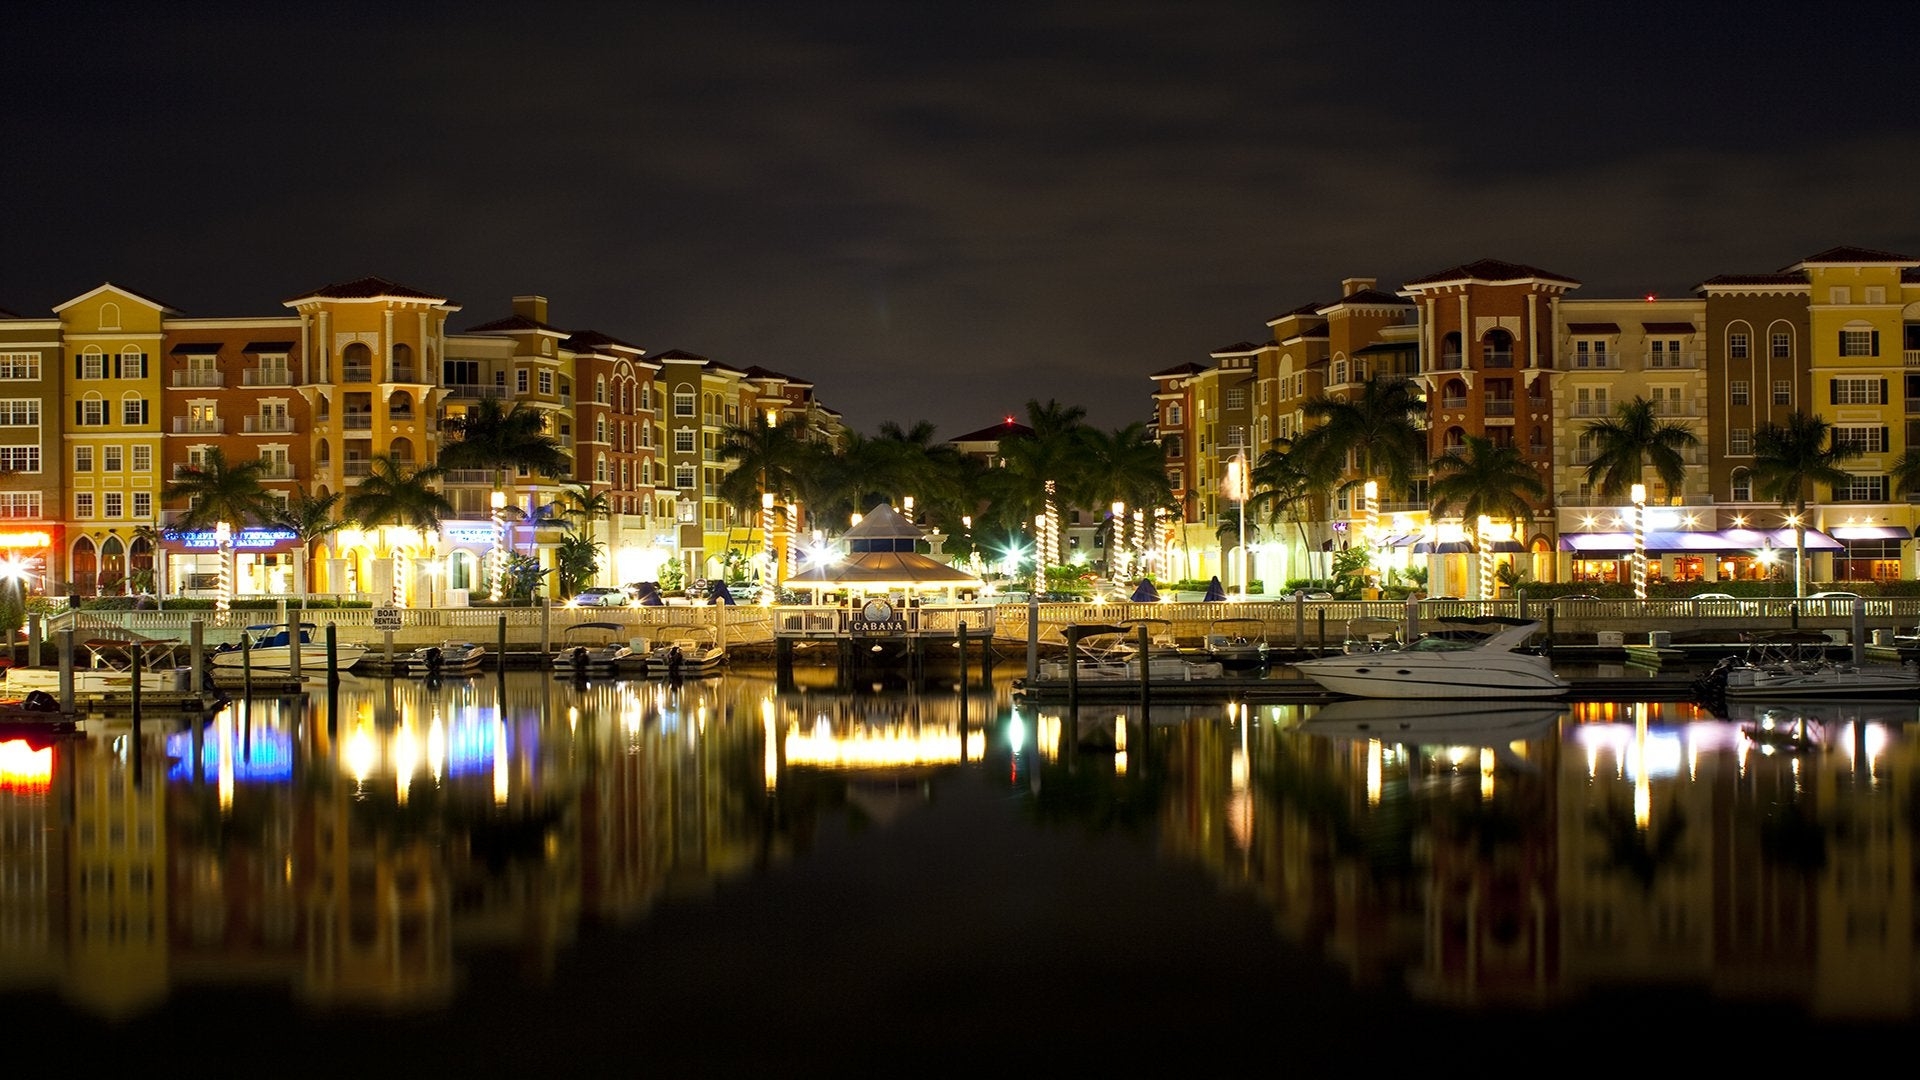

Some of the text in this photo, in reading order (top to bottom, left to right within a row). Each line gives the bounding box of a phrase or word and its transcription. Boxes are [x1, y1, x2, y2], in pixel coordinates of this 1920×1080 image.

[377, 609, 398, 617] BOAT
[374, 617, 402, 625] RENTALS
[853, 622, 903, 631] CABANA
